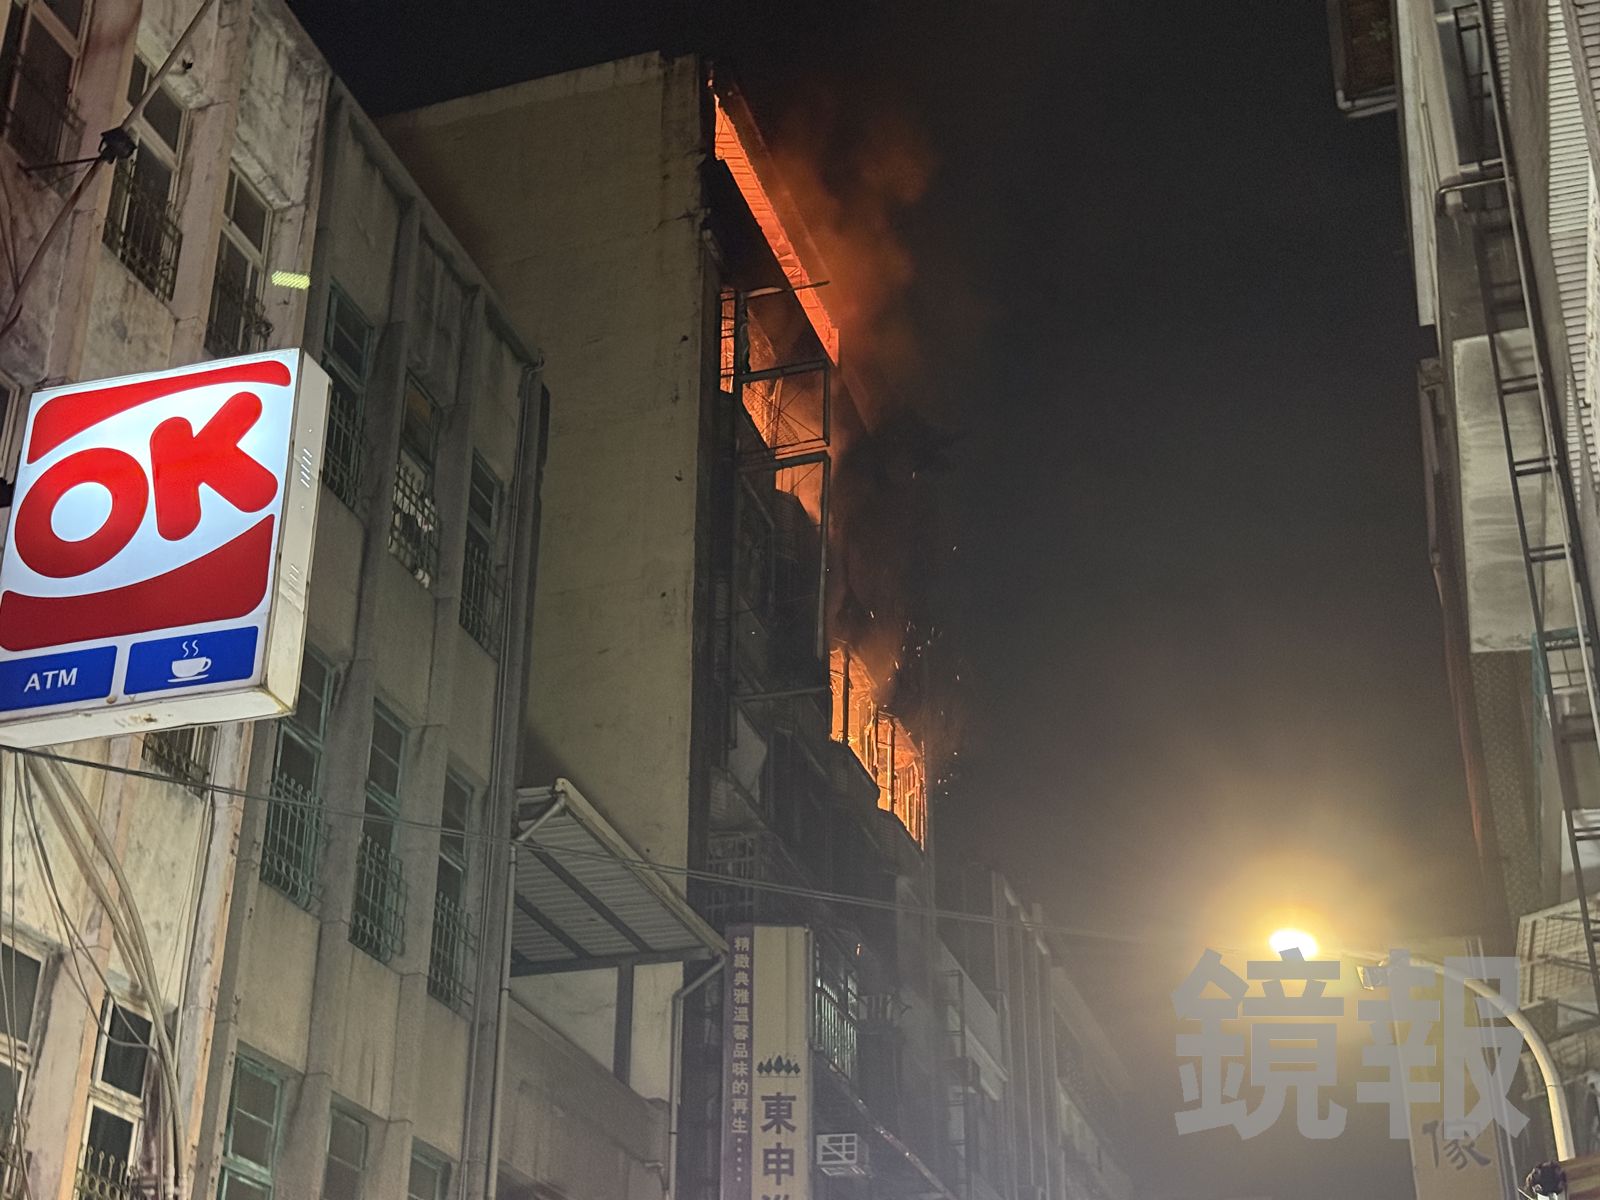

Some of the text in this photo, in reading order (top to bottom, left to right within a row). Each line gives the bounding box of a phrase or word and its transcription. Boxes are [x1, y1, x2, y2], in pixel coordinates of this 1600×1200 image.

[14, 391, 278, 579] OK
[24, 667, 78, 693] ATM
[760, 1092, 797, 1200] 東申
